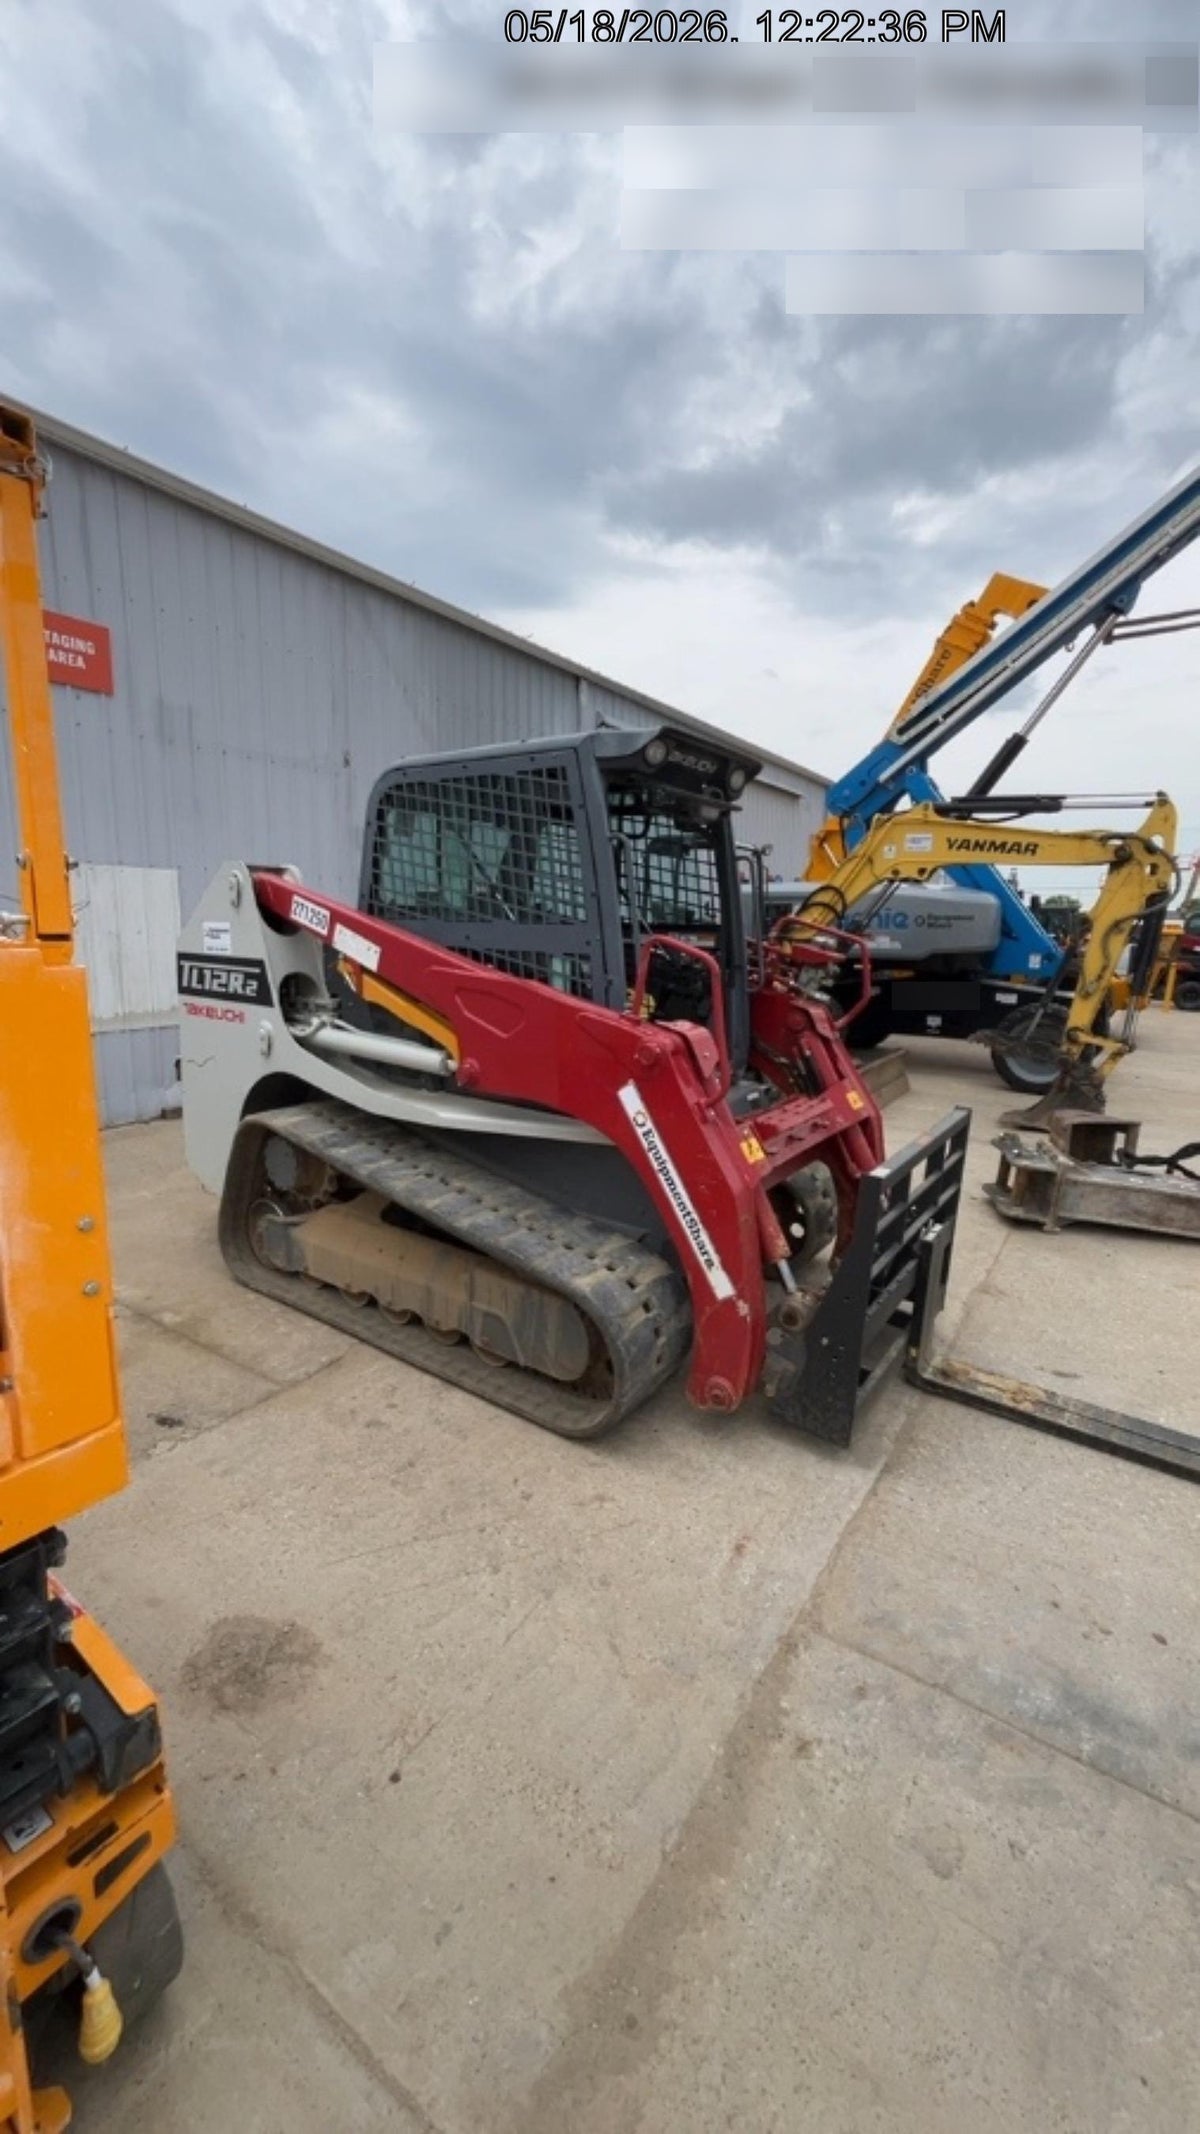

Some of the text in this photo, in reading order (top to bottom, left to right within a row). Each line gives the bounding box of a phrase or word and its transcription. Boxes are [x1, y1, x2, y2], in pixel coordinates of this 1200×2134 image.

[43, 629, 96, 655] TAGING
[48, 647, 86, 670] AREA
[946, 836, 1040, 857] YANMAR
